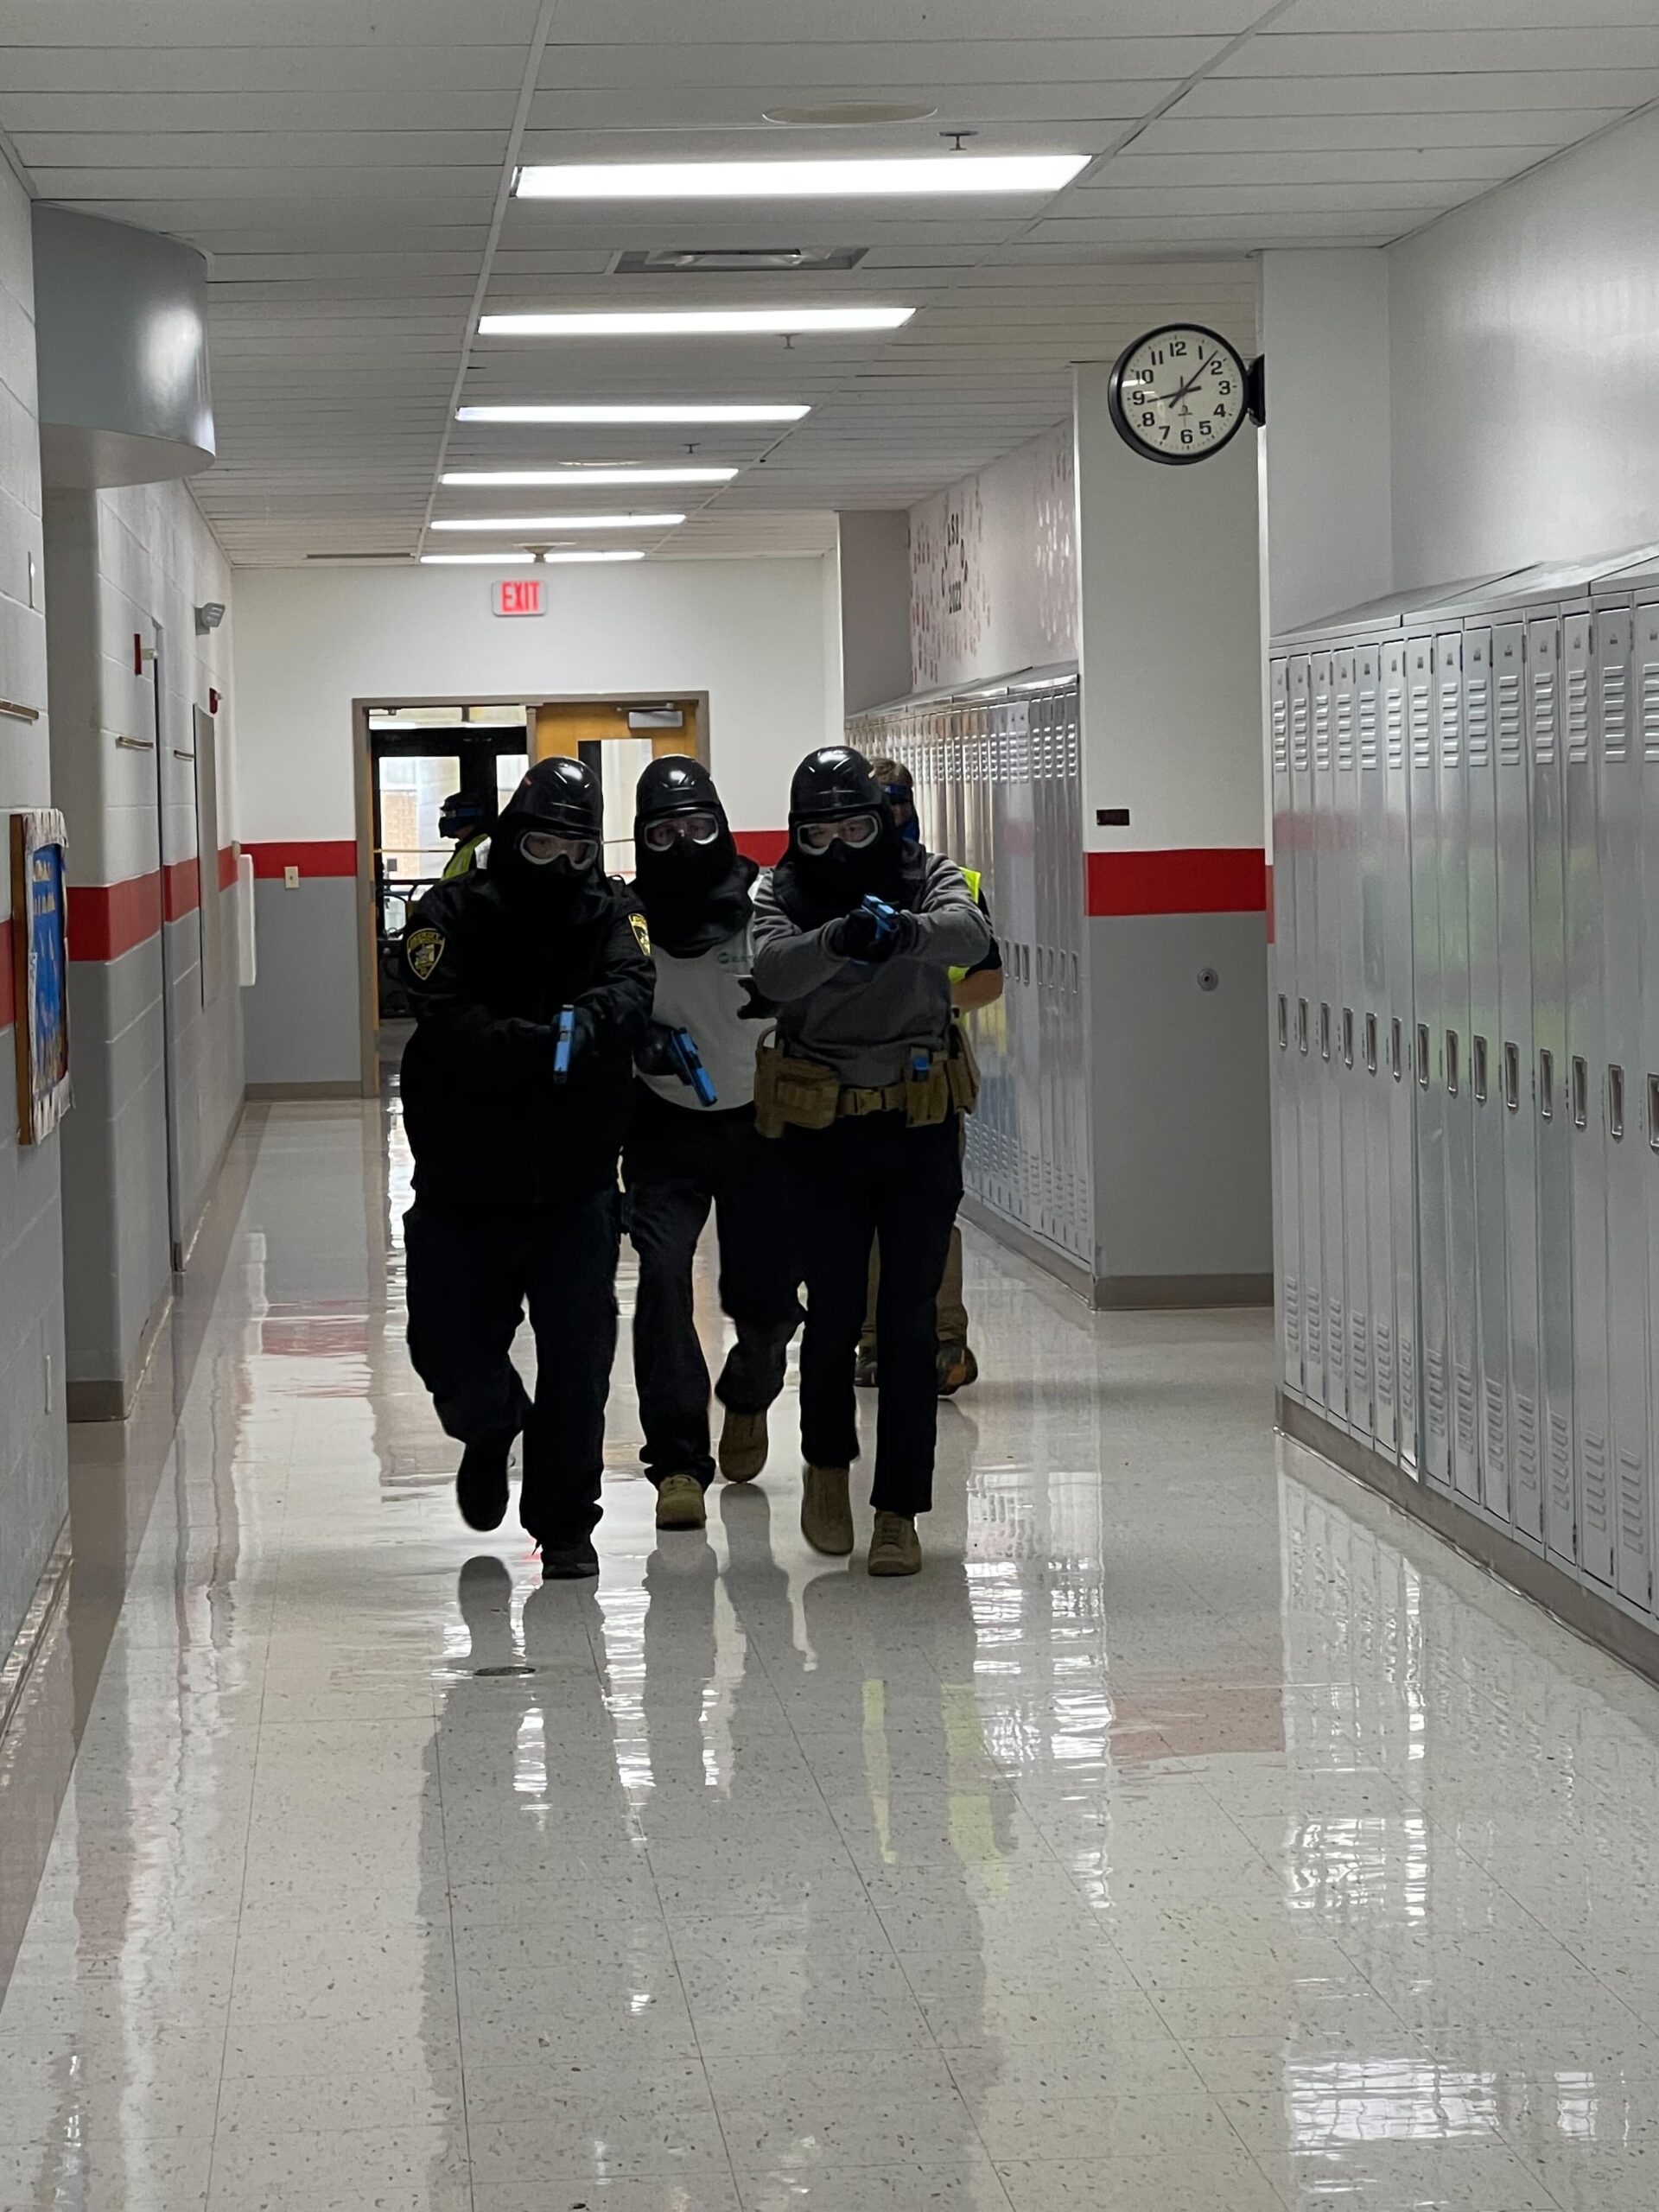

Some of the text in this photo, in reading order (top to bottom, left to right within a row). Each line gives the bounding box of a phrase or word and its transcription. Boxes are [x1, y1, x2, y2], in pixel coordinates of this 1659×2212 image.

[1170, 341, 1187, 357] 12
[1198, 345, 1204, 360] 1
[1151, 350, 1164, 365] 11
[1210, 360, 1224, 375] 2
[1135, 369, 1154, 384] 10
[1218, 380, 1230, 395] 3
[1132, 391, 1145, 405] 9
[1213, 404, 1226, 417] 4
[1141, 411, 1155, 427] 8
[1158, 425, 1171, 441] 7
[1198, 420, 1211, 435] 5
[1180, 429, 1193, 444] 6
[501, 580, 540, 612] EXIT
